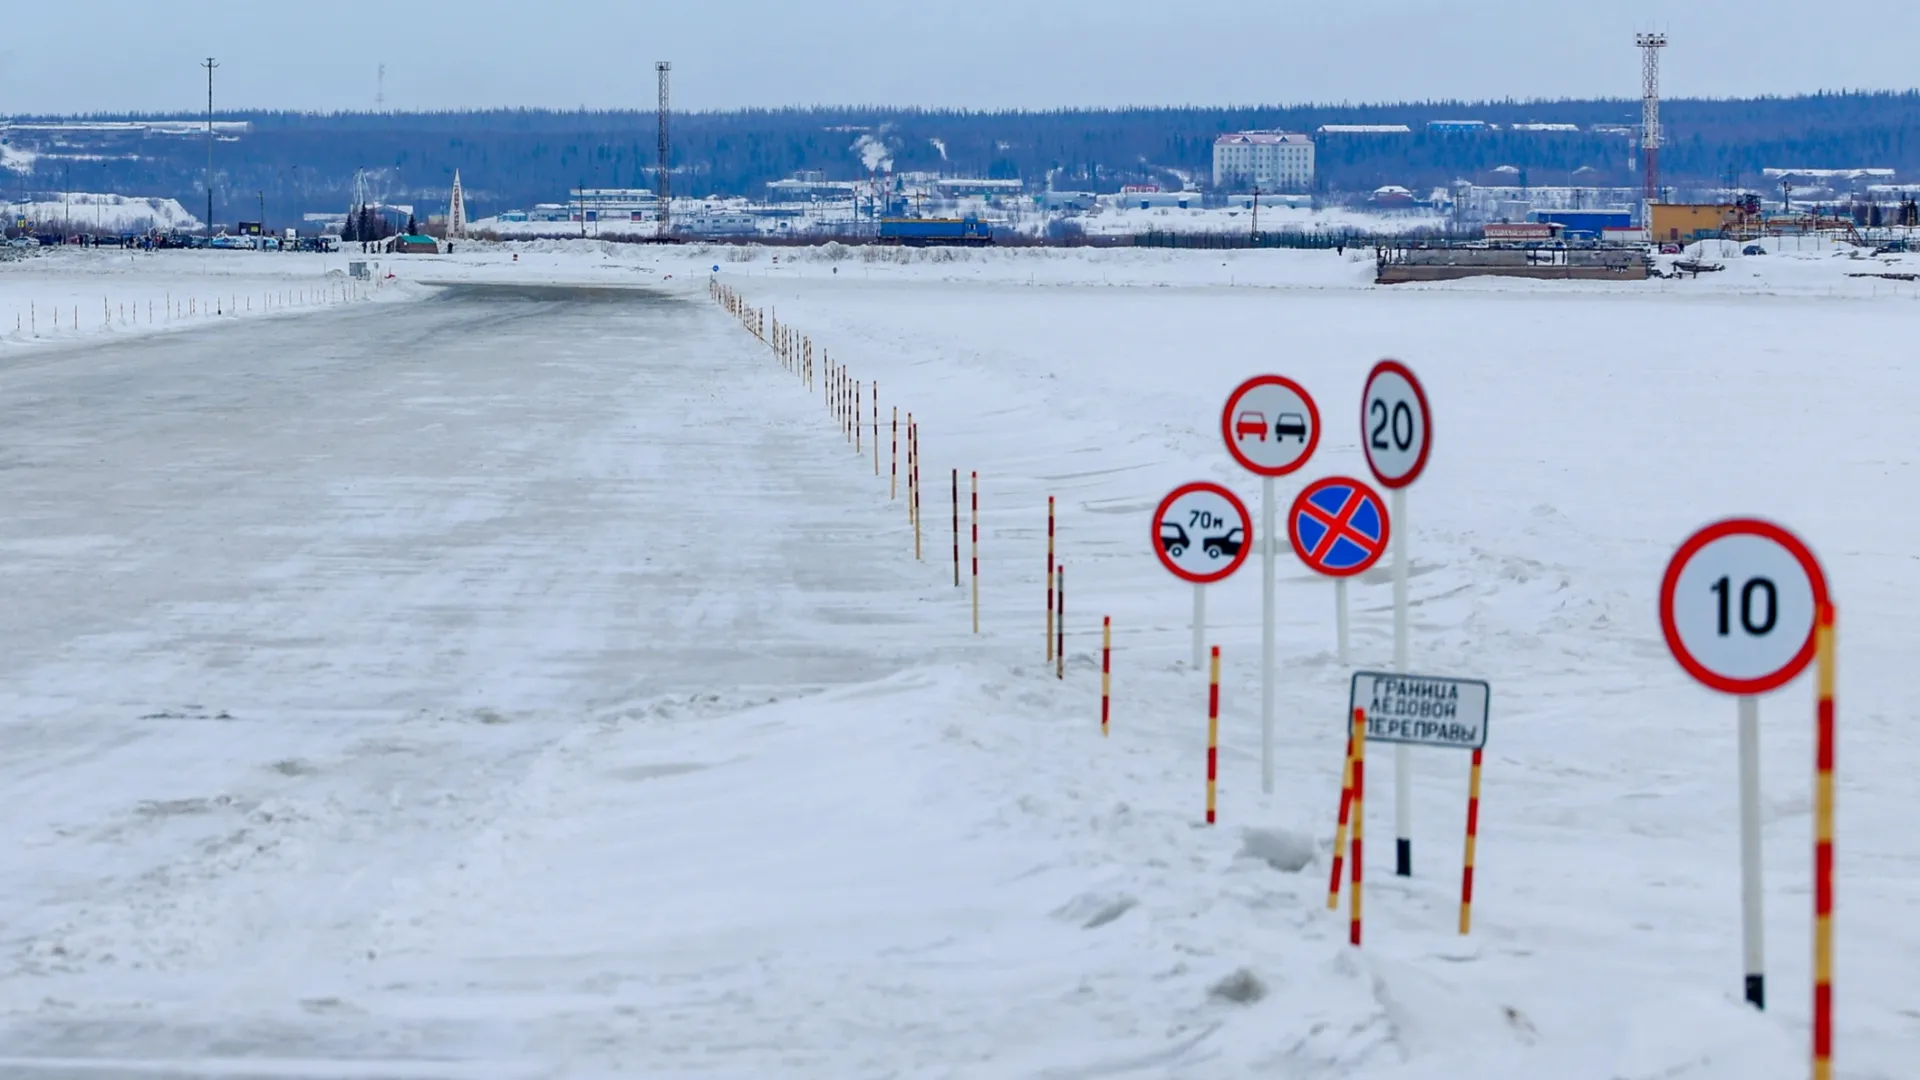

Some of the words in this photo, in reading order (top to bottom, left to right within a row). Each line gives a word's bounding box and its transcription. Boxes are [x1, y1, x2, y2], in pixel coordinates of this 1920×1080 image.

[1370, 397, 1414, 452] 20
[1710, 575, 1779, 637] 10
[1370, 696, 1457, 719] ЛЕДОВОЙ
[1373, 677, 1459, 699] ГРАНИЦА
